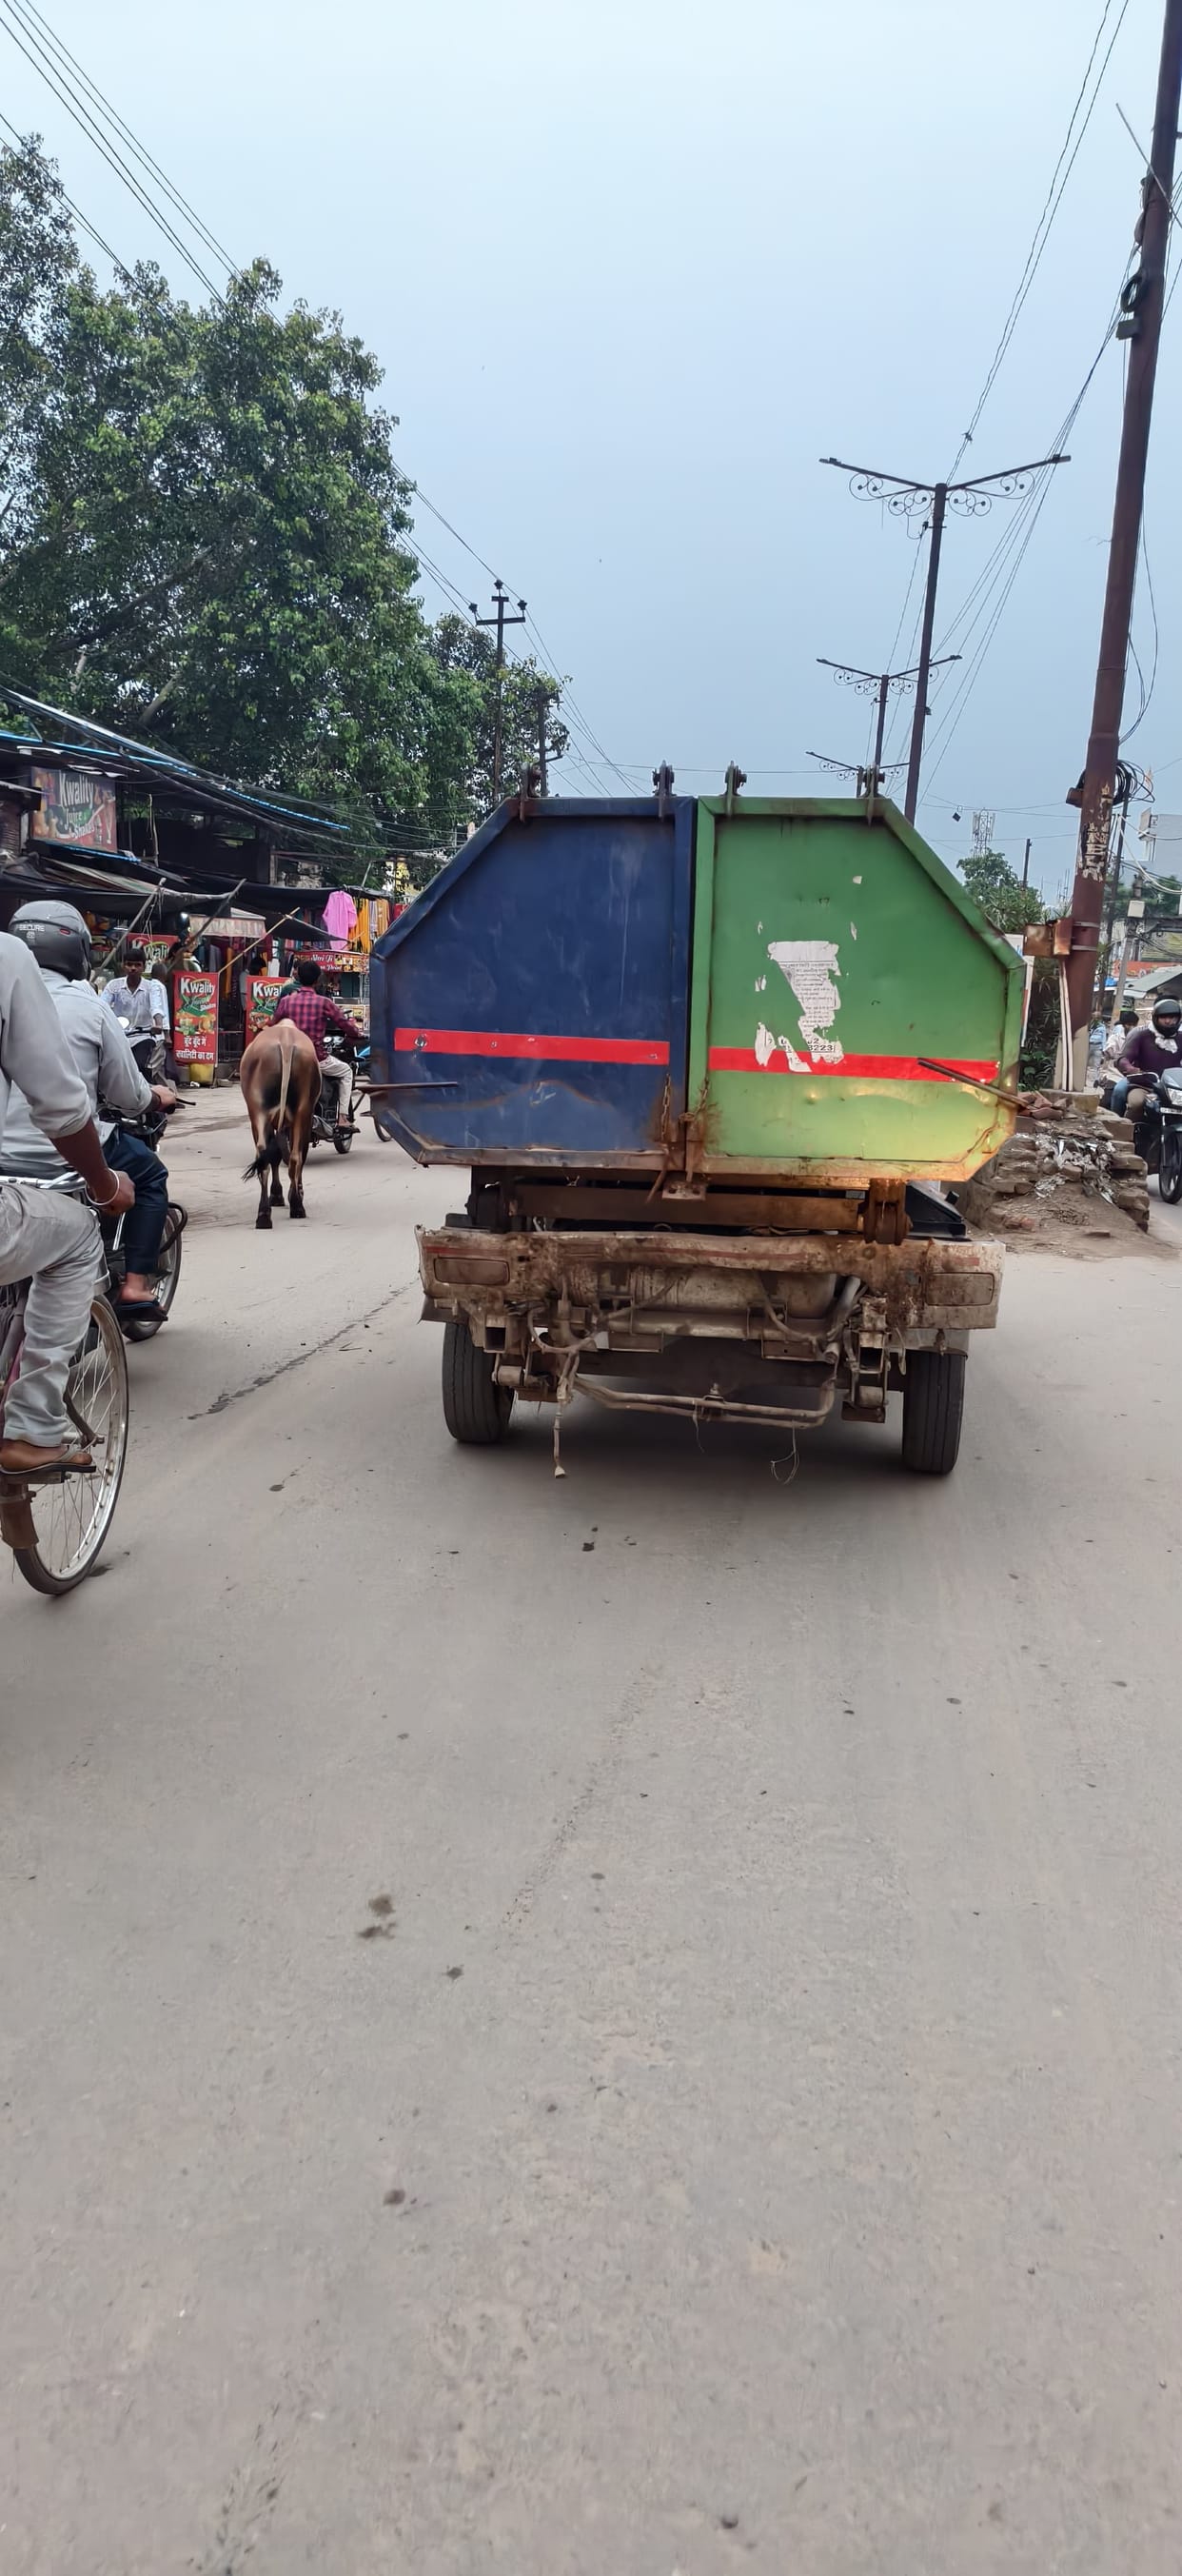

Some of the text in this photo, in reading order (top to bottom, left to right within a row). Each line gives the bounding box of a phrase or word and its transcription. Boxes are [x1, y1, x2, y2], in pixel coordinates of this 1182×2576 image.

[59, 770, 93, 809] Kwality
[19, 923, 45, 932] SECURE
[181, 978, 215, 996] Kwality
[252, 981, 283, 998] Kwal
